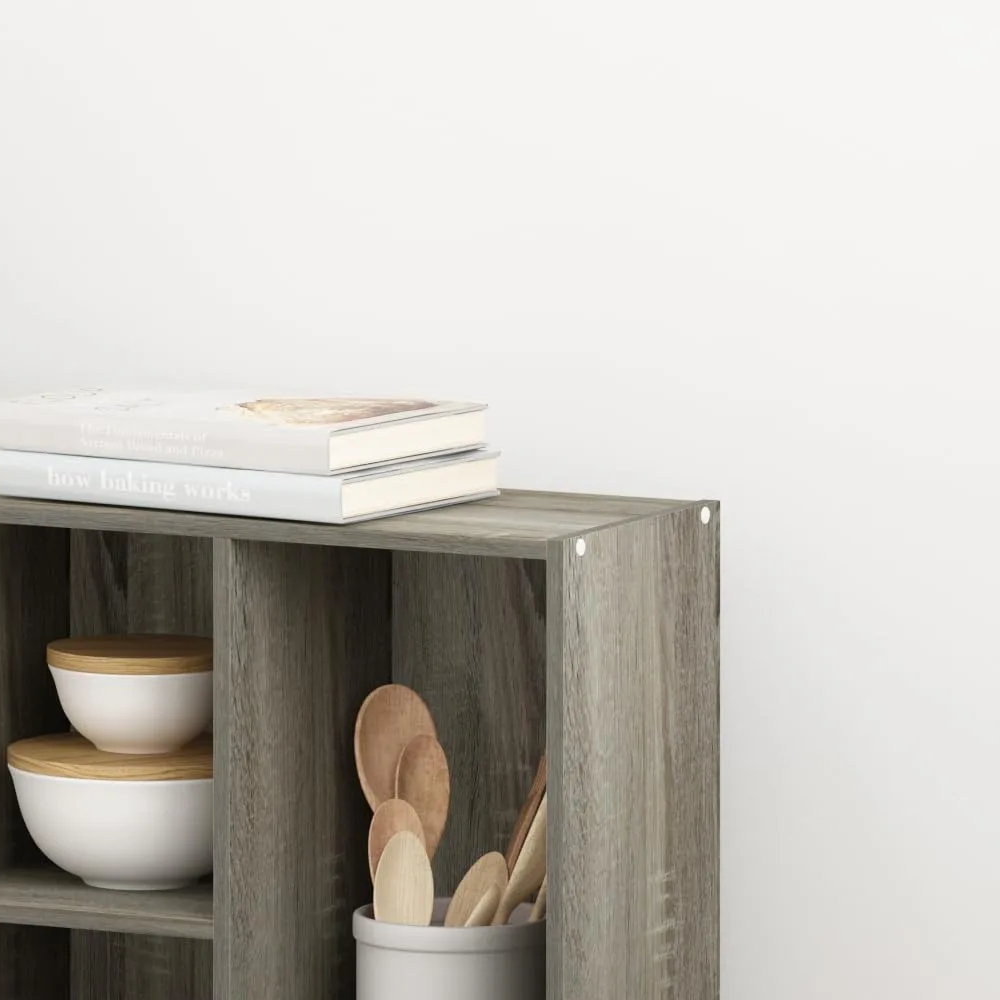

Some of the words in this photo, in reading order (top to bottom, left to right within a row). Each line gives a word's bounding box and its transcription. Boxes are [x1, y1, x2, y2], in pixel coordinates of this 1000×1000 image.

[47, 466, 90, 488] how
[100, 469, 175, 499] baking
[184, 480, 251, 501] works
